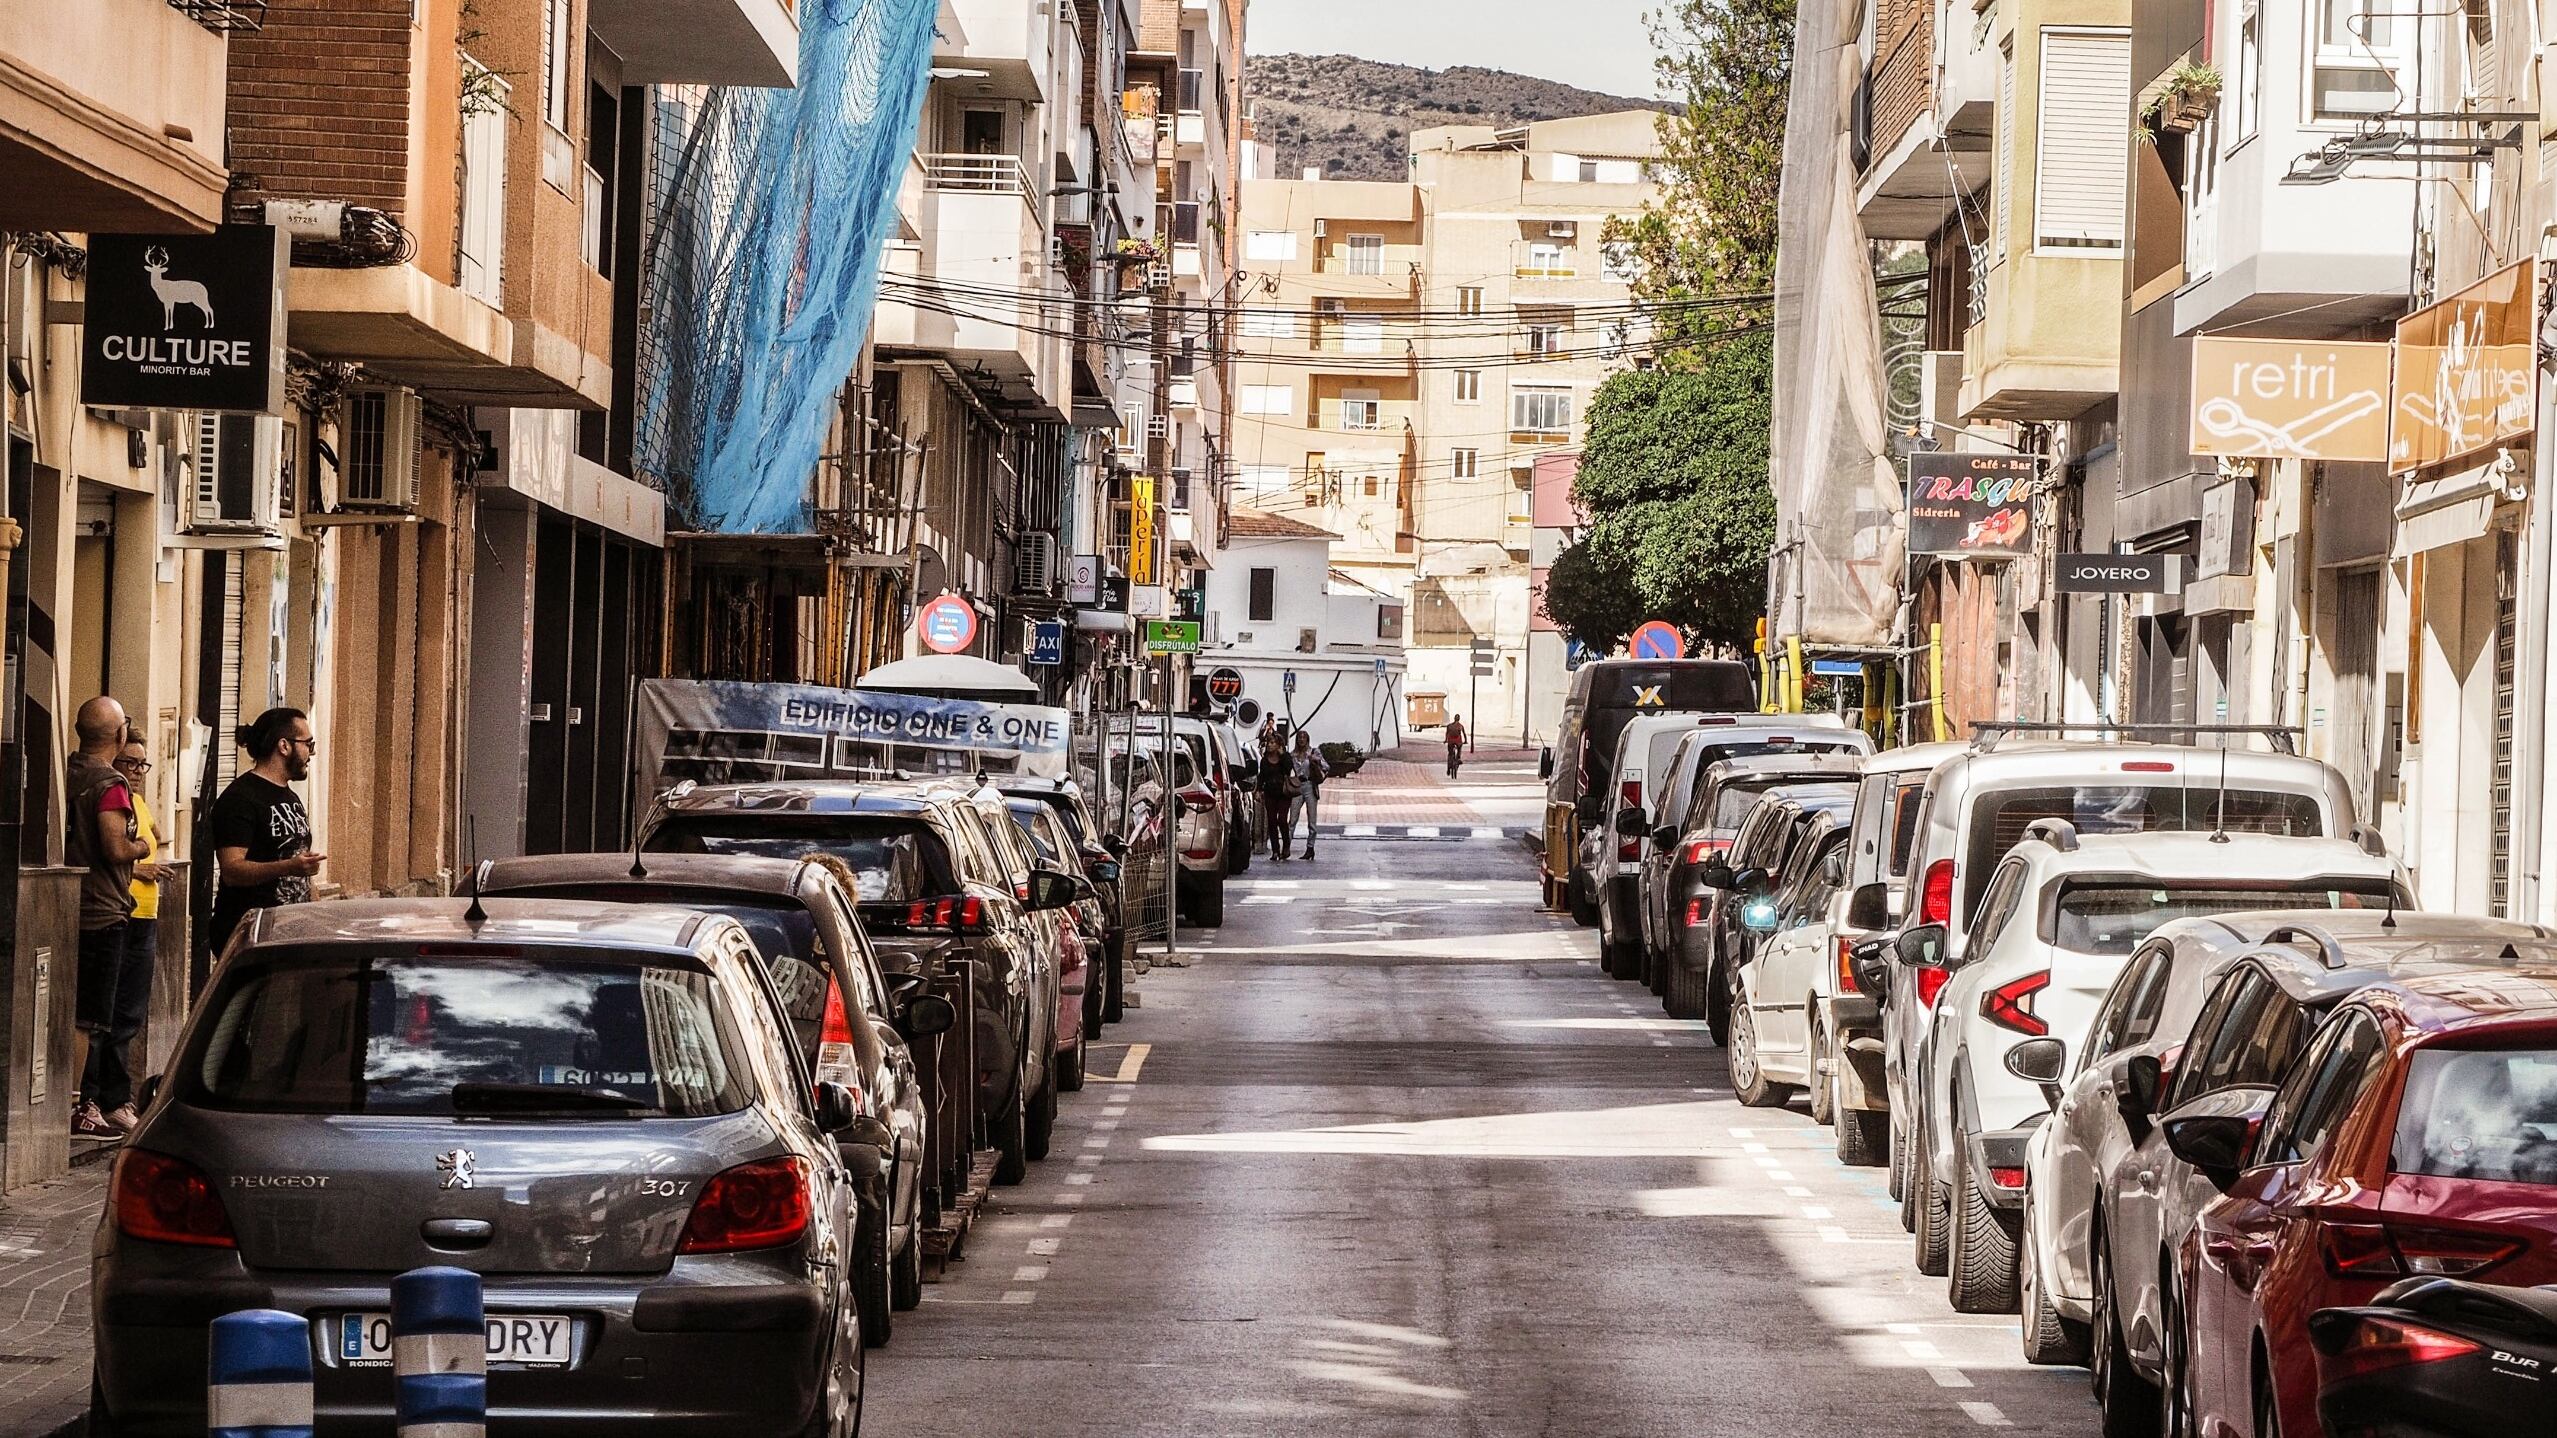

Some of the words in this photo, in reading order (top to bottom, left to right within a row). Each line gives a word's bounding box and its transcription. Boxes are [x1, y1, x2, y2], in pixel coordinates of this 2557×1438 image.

[102, 335, 250, 366] CULTURE
[140, 365, 188, 375] MINORITY
[189, 367, 211, 376] BAR
[2232, 353, 2337, 400] retri
[1971, 459, 1998, 470] Café
[2010, 461, 2031, 470] Bar
[1913, 476, 2032, 507] TRASGU
[1134, 479, 1151, 584] Tapería
[2070, 567, 2151, 580] JOYERO
[1149, 640, 1196, 651] DISFRÚTALO
[1211, 681, 1240, 695] 777
[779, 699, 901, 734] EDIFICIO
[905, 710, 968, 740] ONE
[970, 715, 994, 742] &
[998, 717, 1059, 748] ONE
[230, 1176, 330, 1188] PEUGEOT
[641, 1180, 691, 1196] 307
[348, 1341, 357, 1350] E
